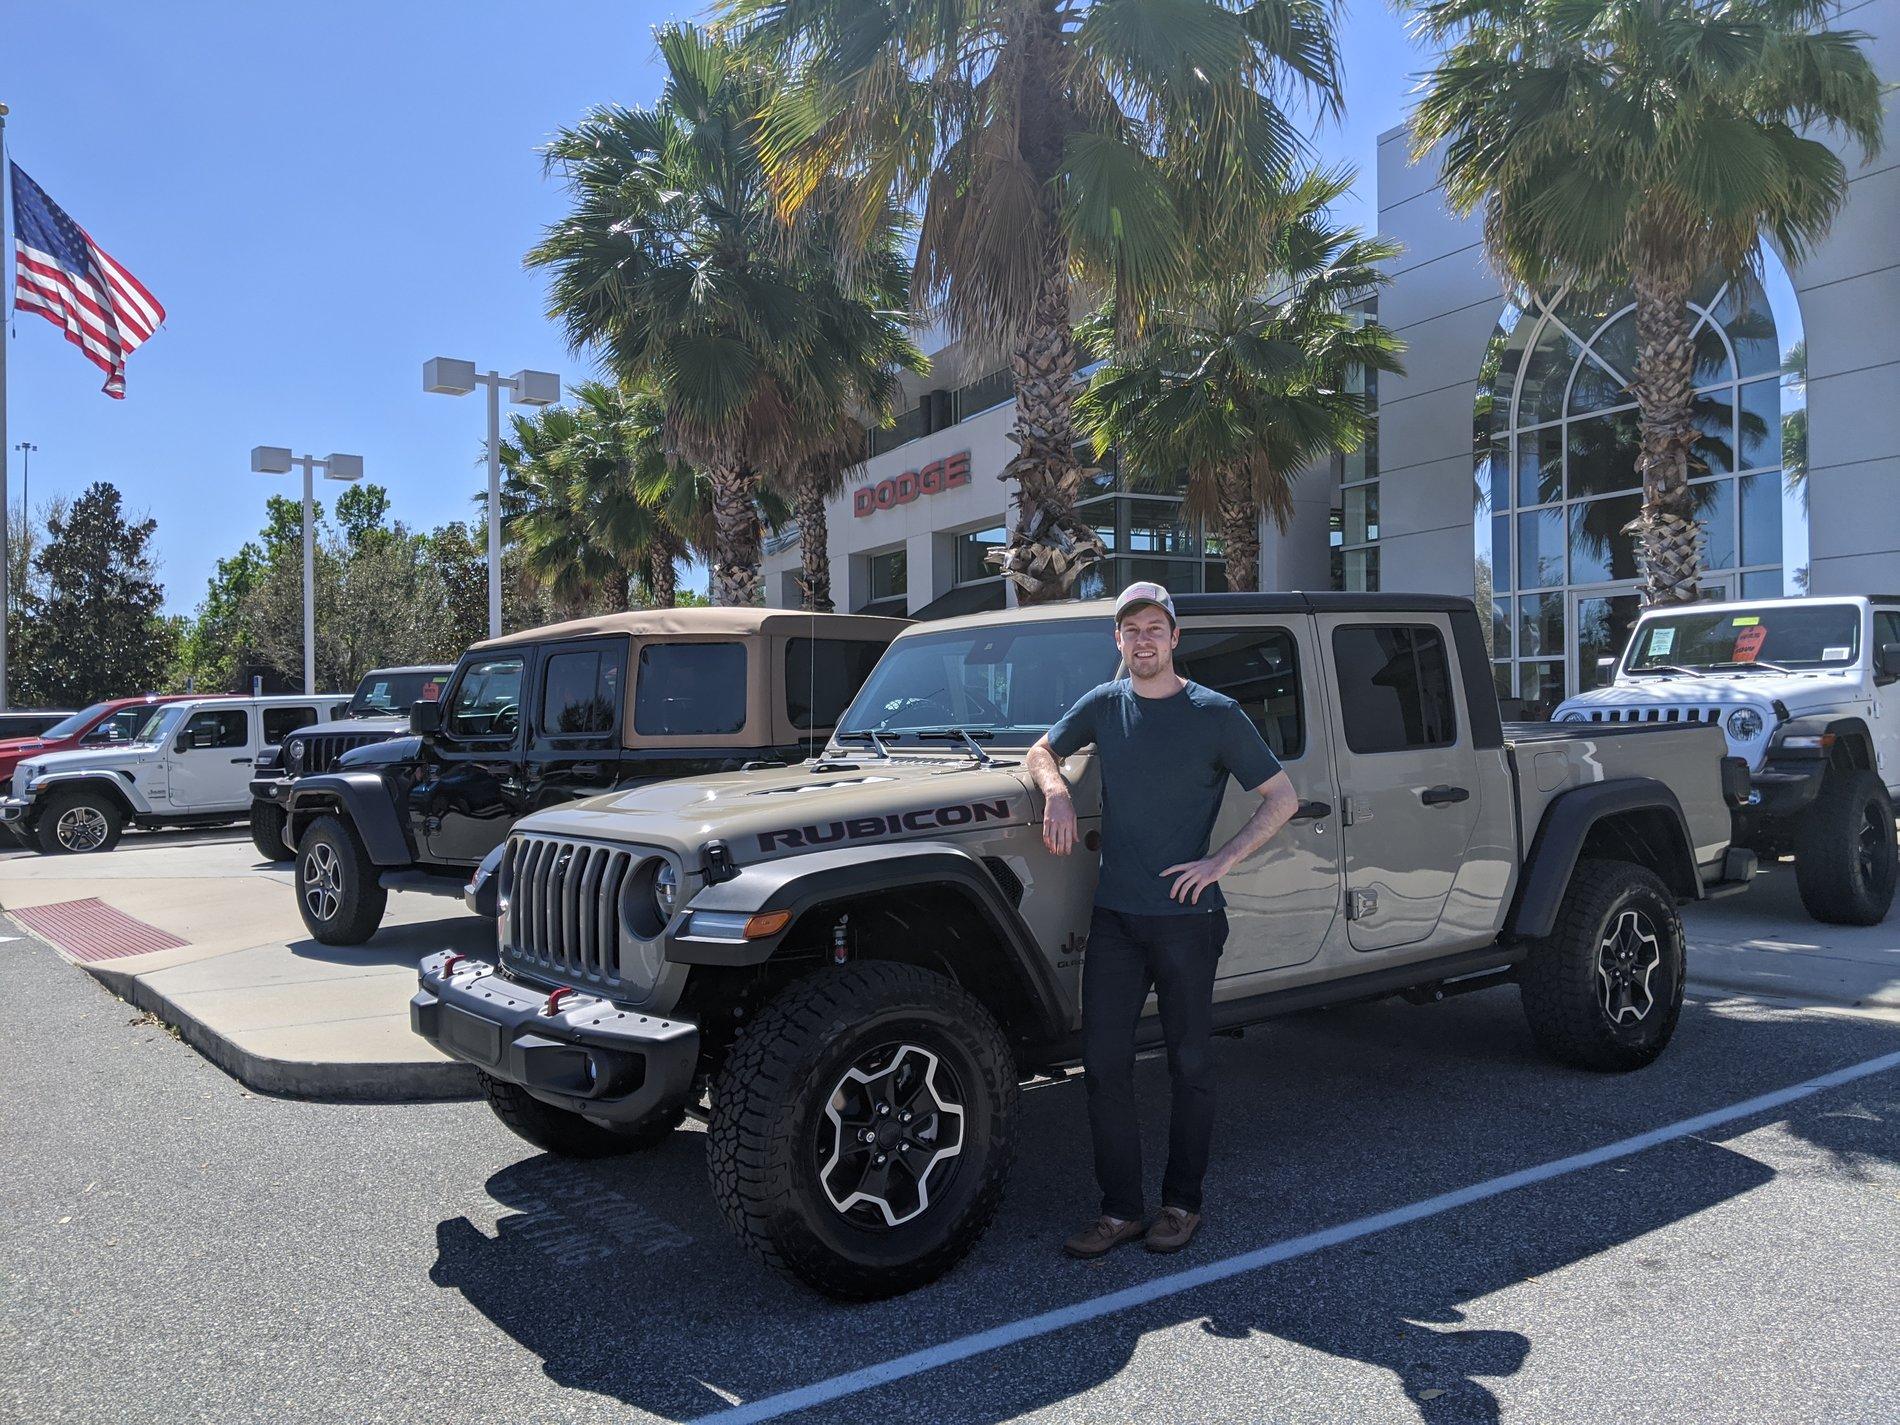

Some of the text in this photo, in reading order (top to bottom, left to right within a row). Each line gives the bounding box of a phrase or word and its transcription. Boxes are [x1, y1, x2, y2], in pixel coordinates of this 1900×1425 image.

[854, 450, 970, 517] DODGE
[757, 800, 1010, 852] RUBICON
[1061, 932, 1087, 954] Je
